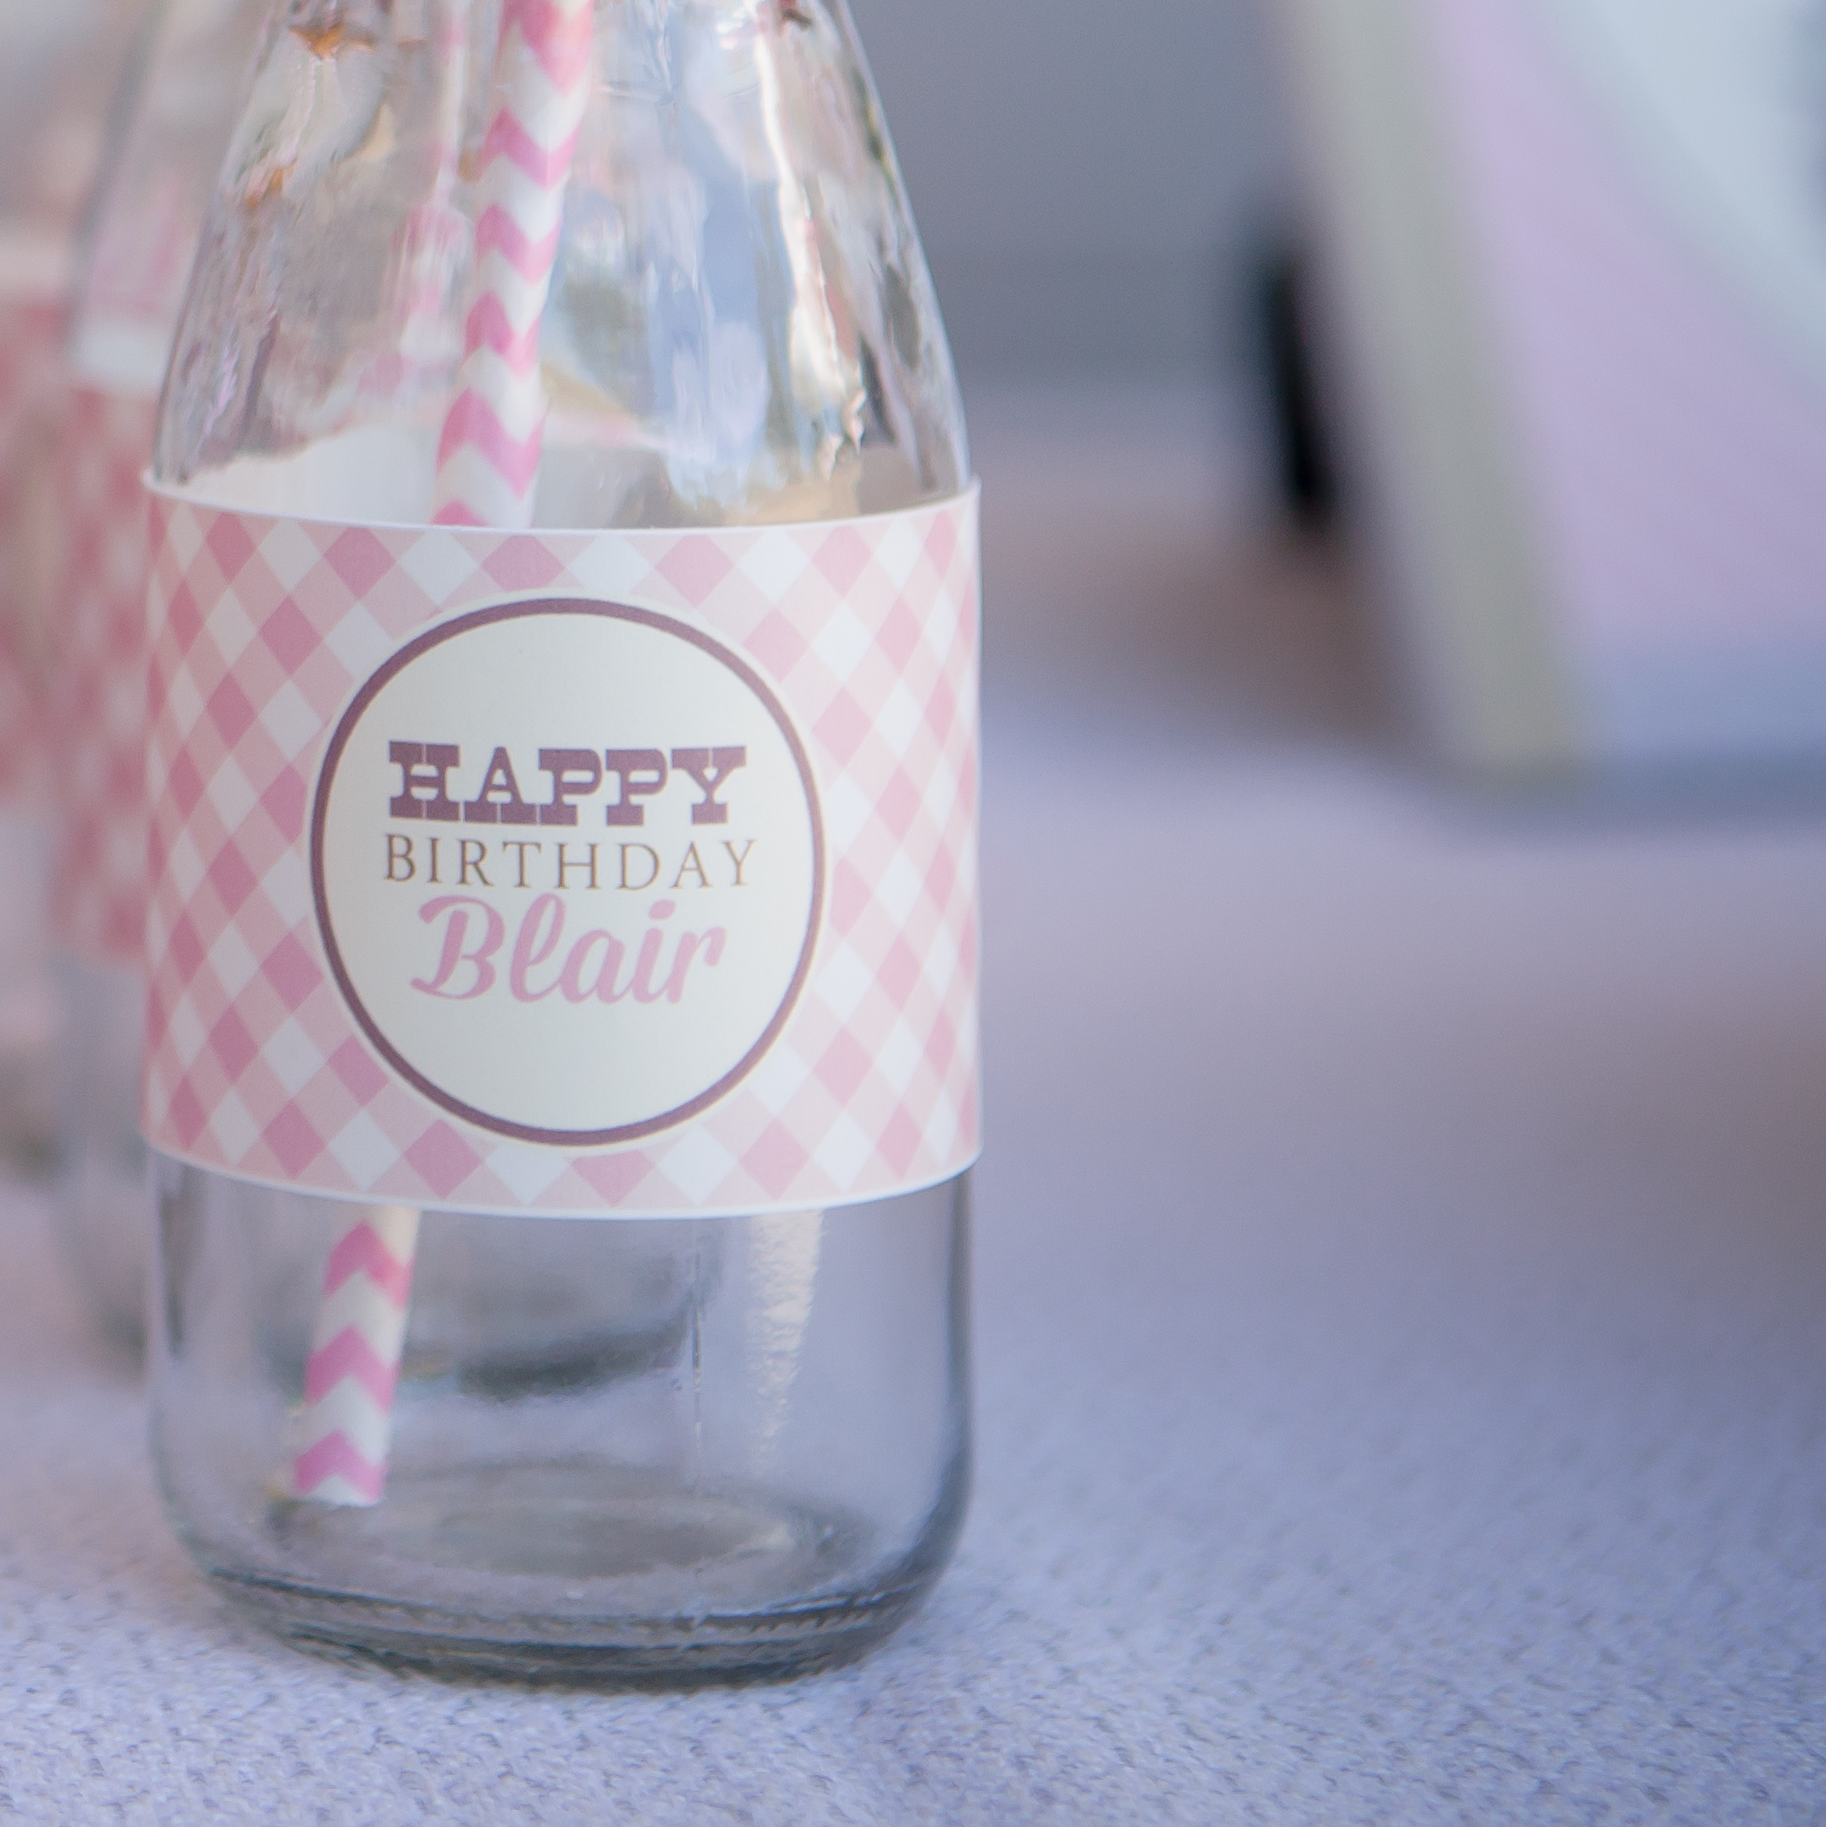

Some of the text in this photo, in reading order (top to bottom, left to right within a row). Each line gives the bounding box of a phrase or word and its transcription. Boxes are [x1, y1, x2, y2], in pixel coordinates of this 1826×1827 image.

[388, 740, 747, 827] HAPPY
[383, 833, 758, 890] BIRTHDAY
[410, 893, 727, 1005] Blair
